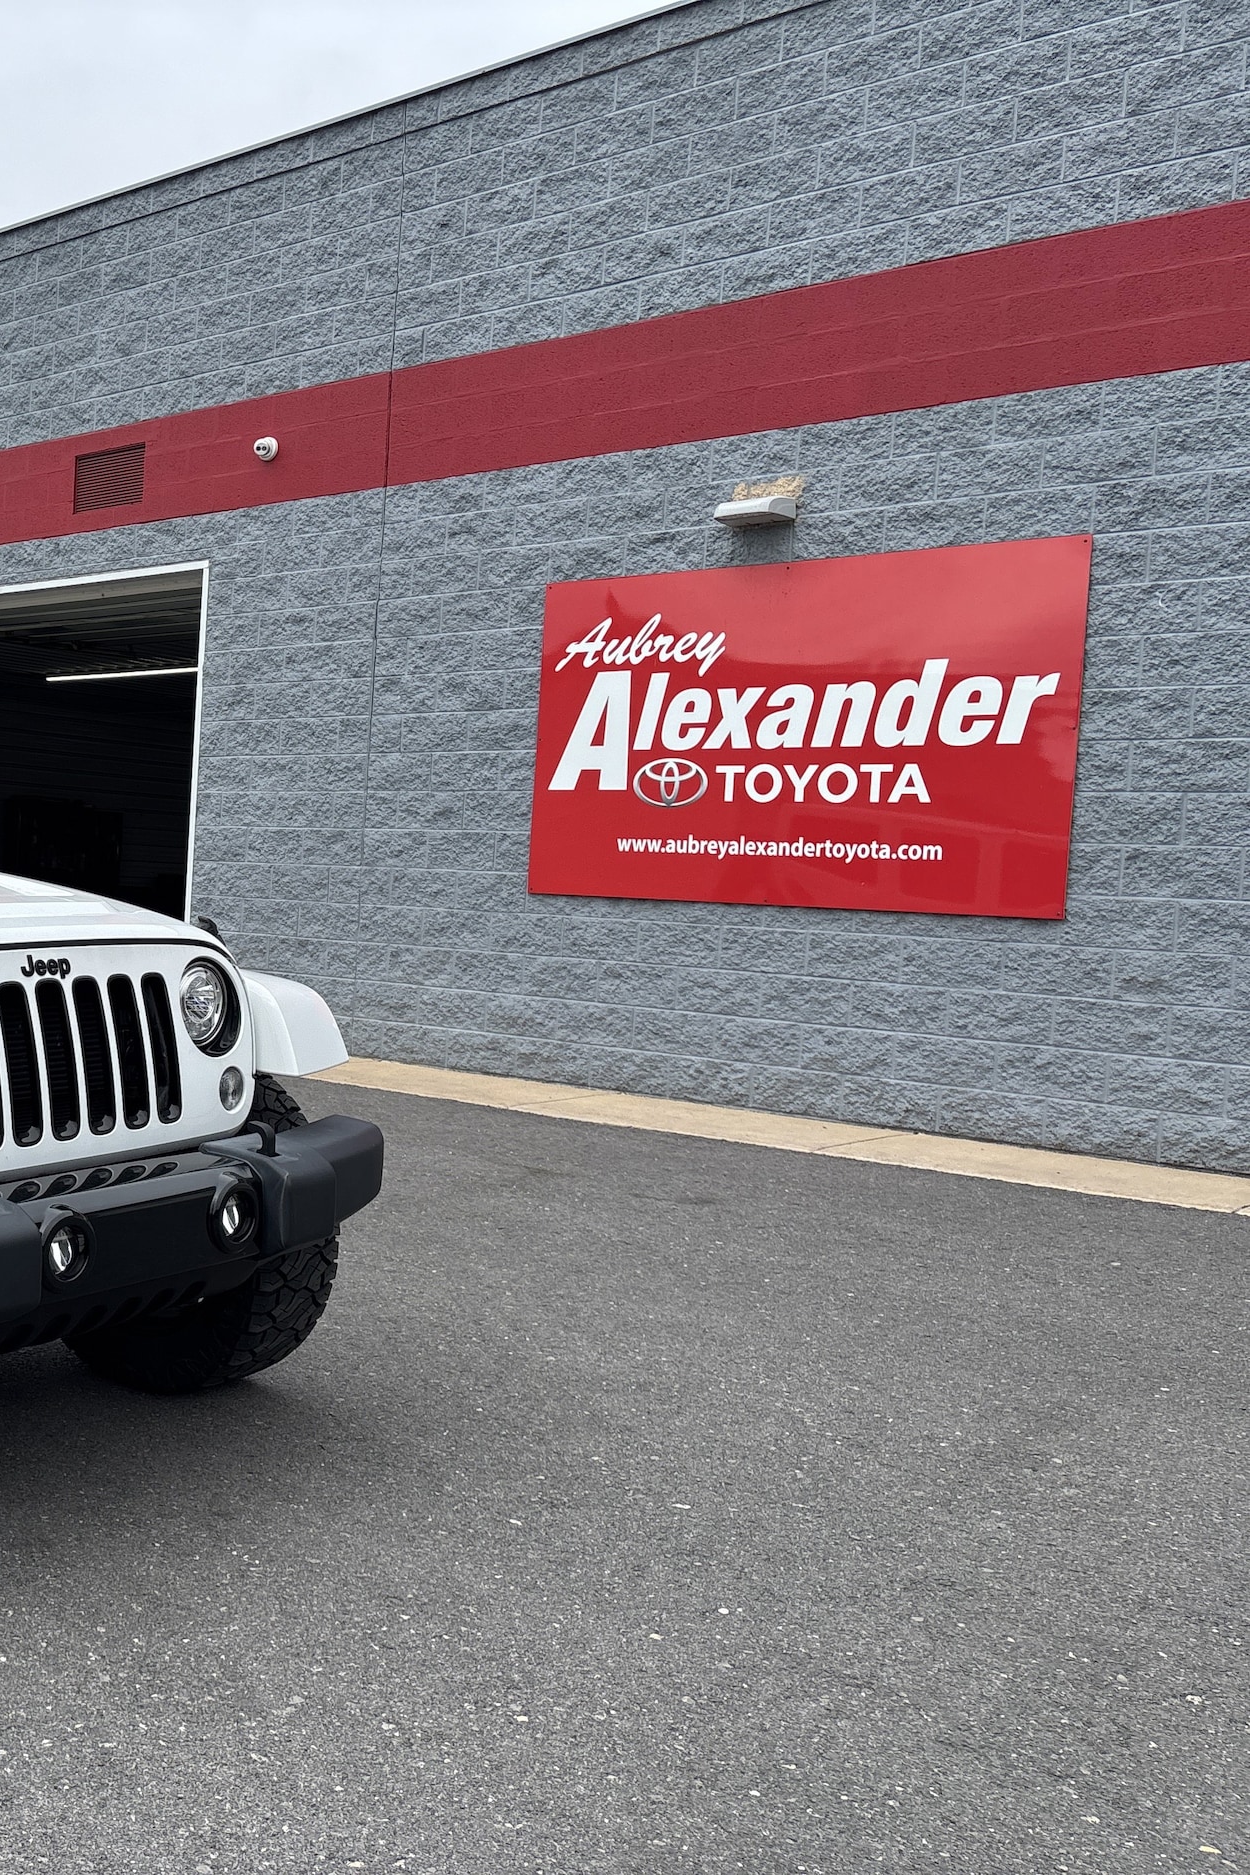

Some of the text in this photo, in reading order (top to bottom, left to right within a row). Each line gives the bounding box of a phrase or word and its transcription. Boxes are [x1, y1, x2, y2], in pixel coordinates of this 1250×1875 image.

[554, 613, 726, 677] Aubrey
[547, 658, 1061, 791] Alexander
[715, 762, 931, 804] TOYOTA
[617, 834, 943, 864] www.aubreyalexandertoyota.com
[20, 954, 71, 980] Jeep
